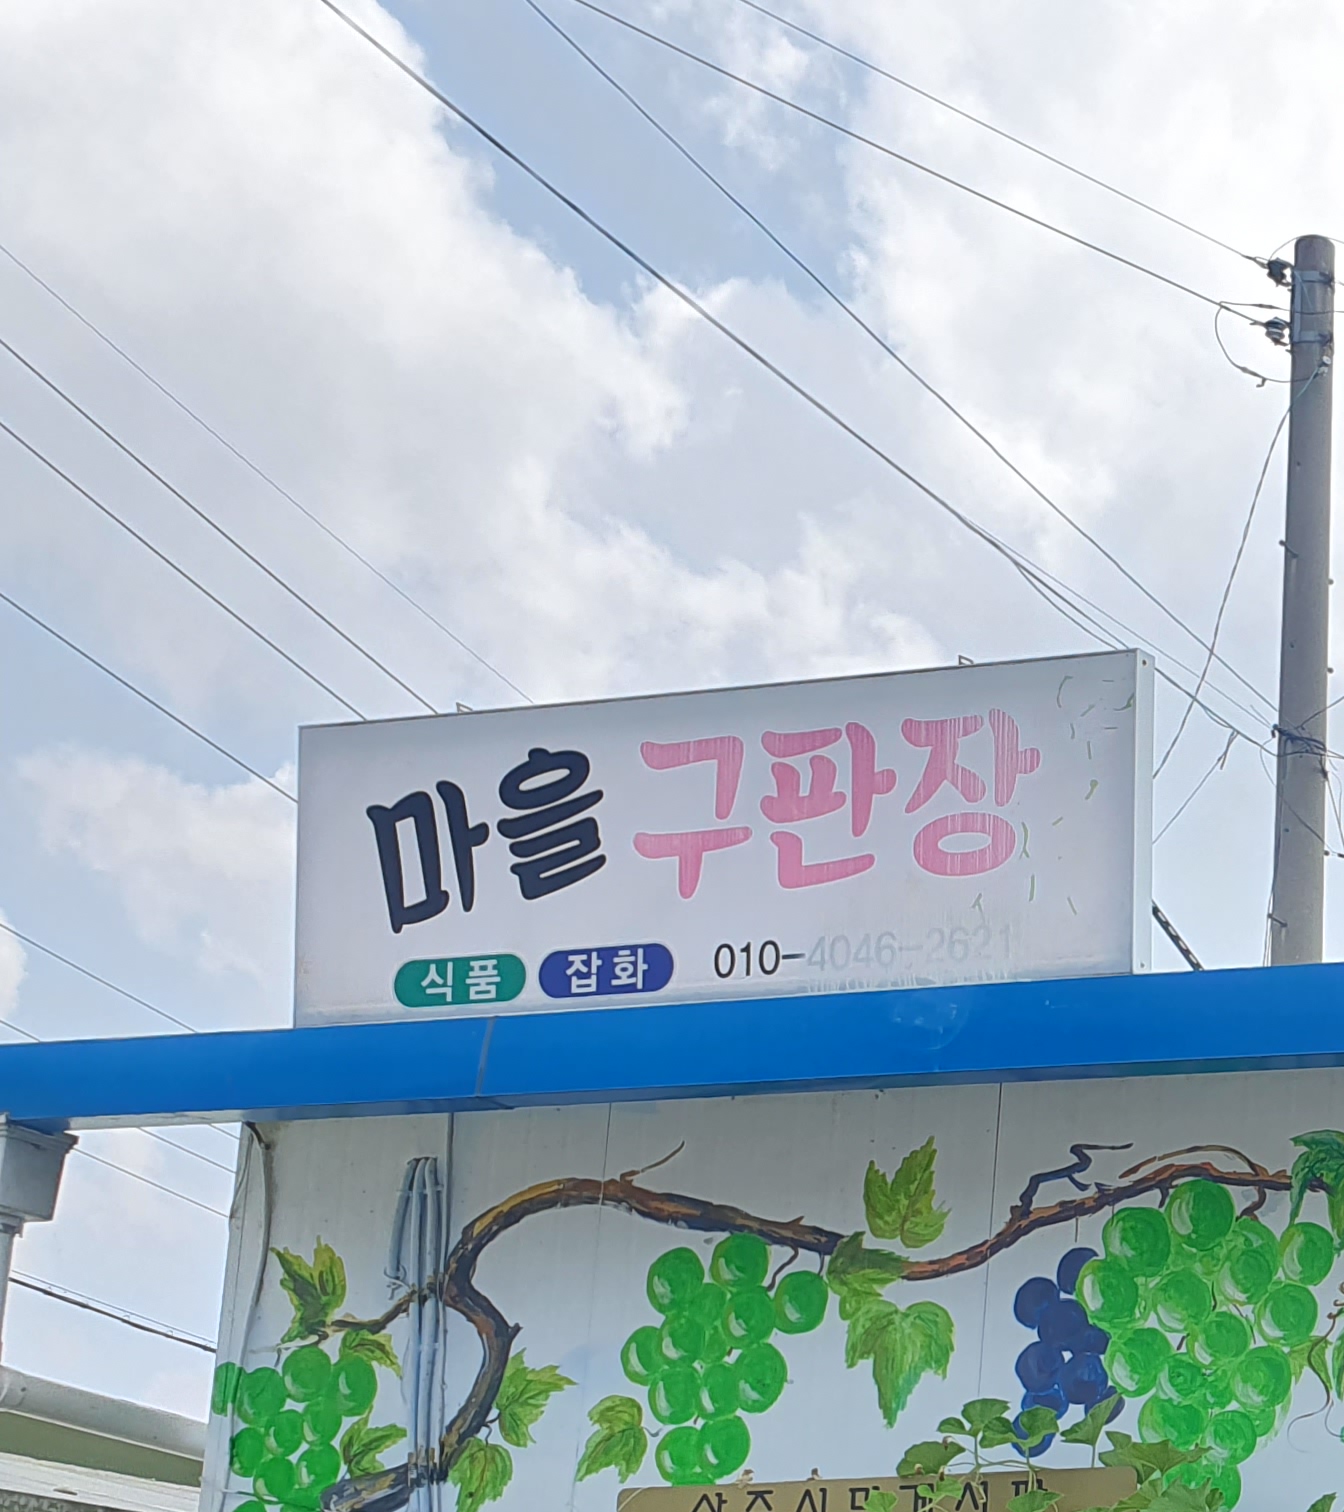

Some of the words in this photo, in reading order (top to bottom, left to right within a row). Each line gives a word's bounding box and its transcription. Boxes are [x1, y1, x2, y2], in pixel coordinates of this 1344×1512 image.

[366, 747, 606, 933] 마을
[633, 708, 1042, 900] 구판장
[420, 959, 503, 1001] 식품
[563, 948, 650, 995] 잡화
